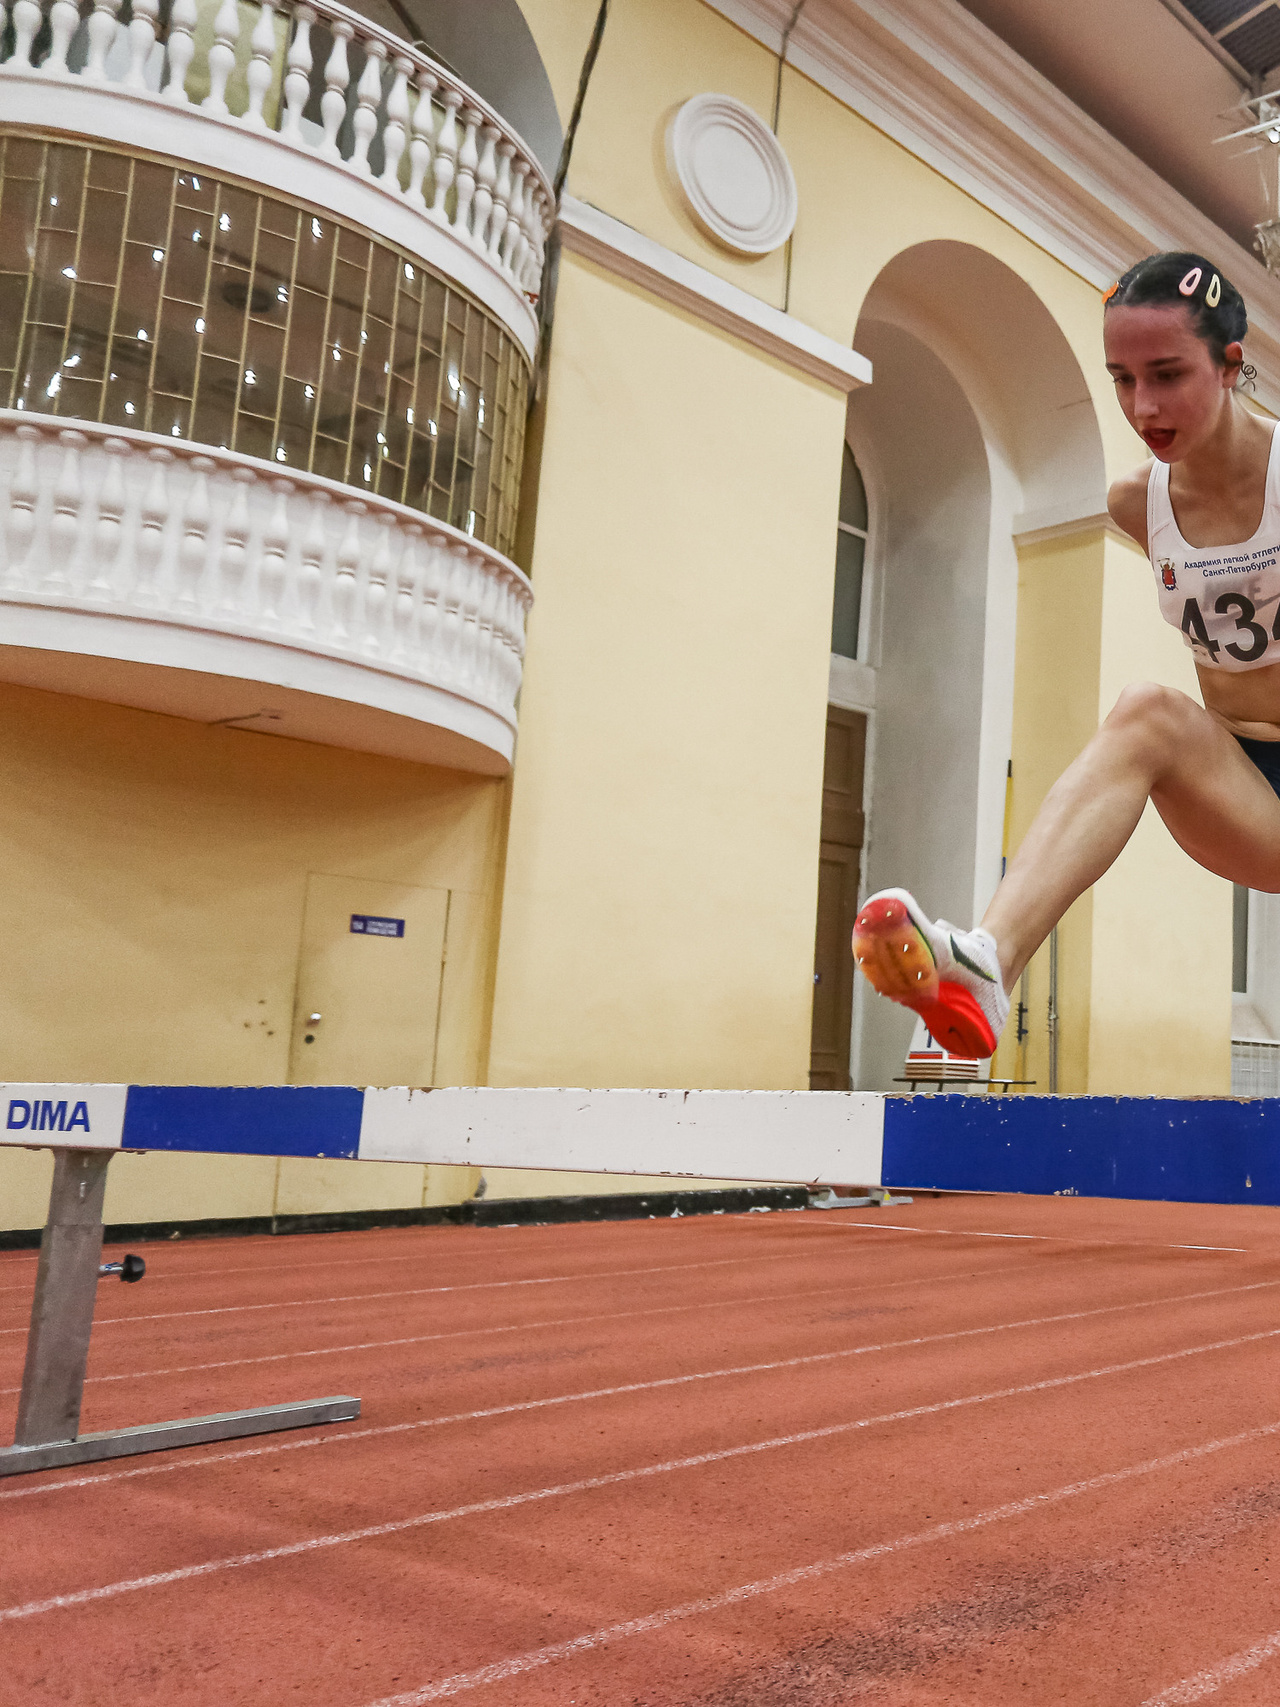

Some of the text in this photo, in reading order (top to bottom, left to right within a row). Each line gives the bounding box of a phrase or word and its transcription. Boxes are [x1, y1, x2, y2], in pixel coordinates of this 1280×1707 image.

[1184, 559, 1222, 570] Академия
[1223, 553, 1250, 565] легкой
[1202, 558, 1277, 578] Санкт-Петербурга
[6, 1099, 91, 1133] DIMA
